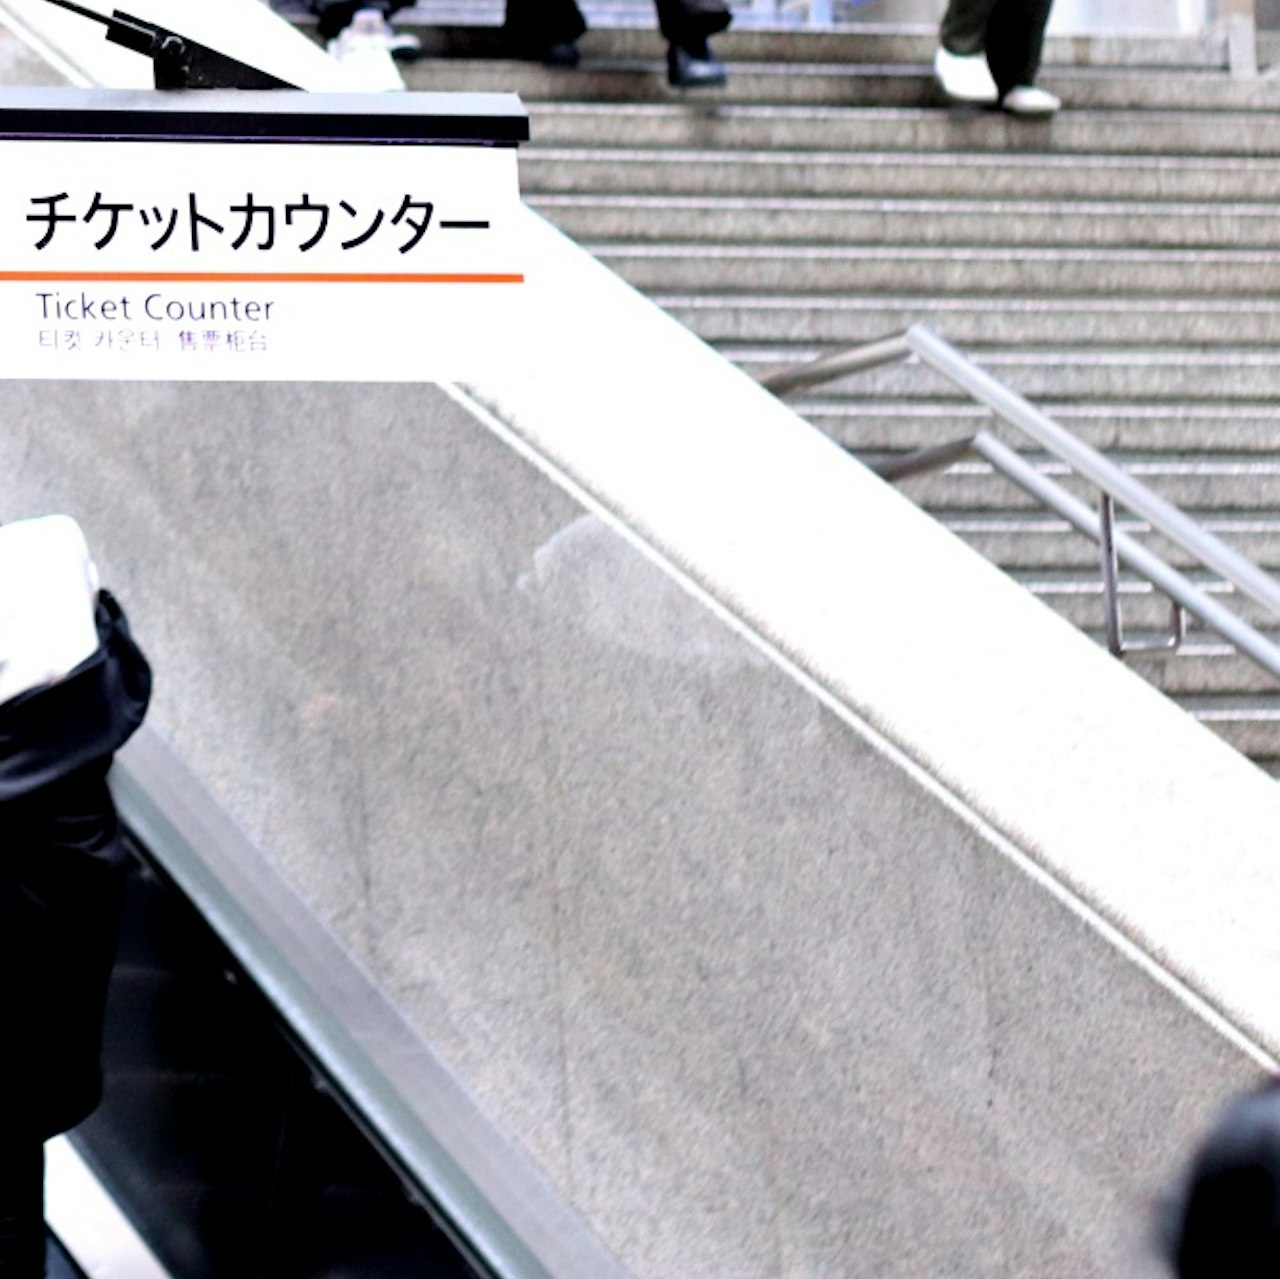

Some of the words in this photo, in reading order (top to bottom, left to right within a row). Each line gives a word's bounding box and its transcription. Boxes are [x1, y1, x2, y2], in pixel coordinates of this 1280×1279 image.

[27, 192, 489, 254] チケットカウンター
[36, 292, 130, 319] Ticket
[145, 294, 273, 321] Counter
